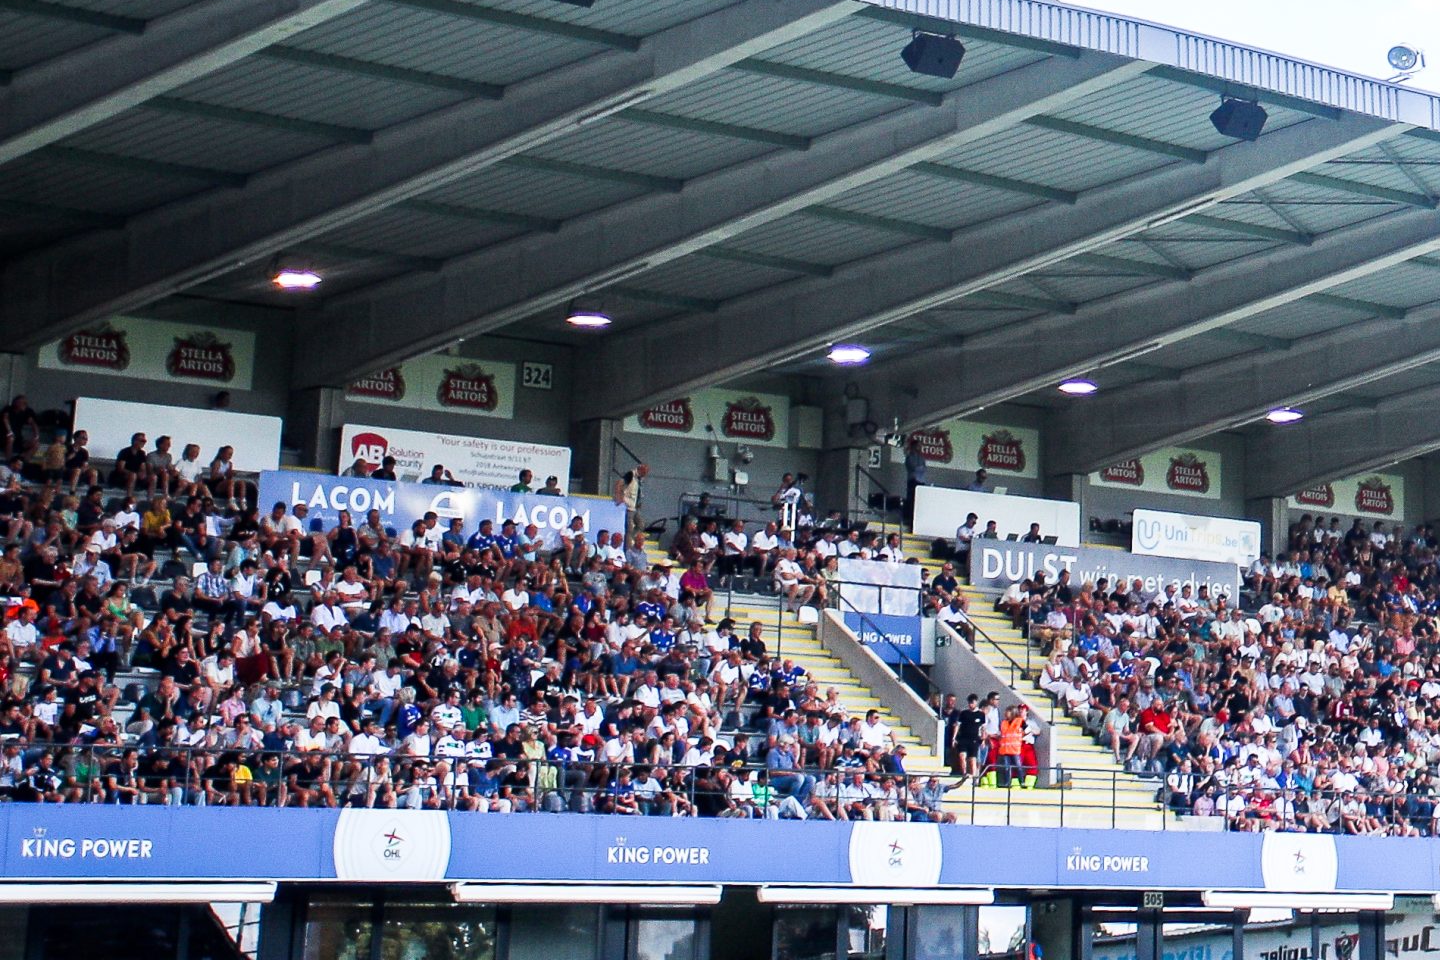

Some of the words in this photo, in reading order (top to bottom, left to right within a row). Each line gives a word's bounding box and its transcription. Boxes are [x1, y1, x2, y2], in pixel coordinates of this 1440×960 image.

[73, 336, 118, 349] STELLA
[71, 347, 118, 361] ARTOIS
[181, 348, 223, 360] STELLA
[179, 359, 223, 373] ARTOIS
[524, 367, 550, 385] 324
[353, 380, 394, 392] ARTOIS
[450, 379, 487, 392] STELLA
[448, 391, 488, 403] ARTOIS
[648, 412, 684, 424] ARTOIS
[731, 412, 765, 423] STELLA
[731, 422, 766, 433] ARTOIS
[463, 439, 488, 450] safety
[491, 442, 498, 450] is
[501, 445, 515, 453] our
[987, 443, 1017, 455] STELLA
[354, 444, 384, 465] AB
[389, 447, 424, 459] Solution
[987, 453, 1018, 465] ARTOIS
[395, 459, 424, 471] ecurity
[1174, 466, 1201, 476] STELLA
[1107, 467, 1137, 478] ARTOIS
[1174, 476, 1202, 485] ARTOIS
[291, 482, 395, 515] LACOM
[1302, 491, 1328, 501] ARTOIS
[1362, 490, 1387, 499] STELLA
[1362, 499, 1387, 508] ARTOIS
[22, 839, 76, 858] KING
[82, 839, 152, 858] POWER
[384, 849, 401, 858] OHL
[608, 847, 650, 863] KING
[653, 847, 709, 864] POWER
[1067, 855, 1101, 871] KING
[1103, 856, 1148, 872] POWER
[1145, 893, 1162, 906] 305
